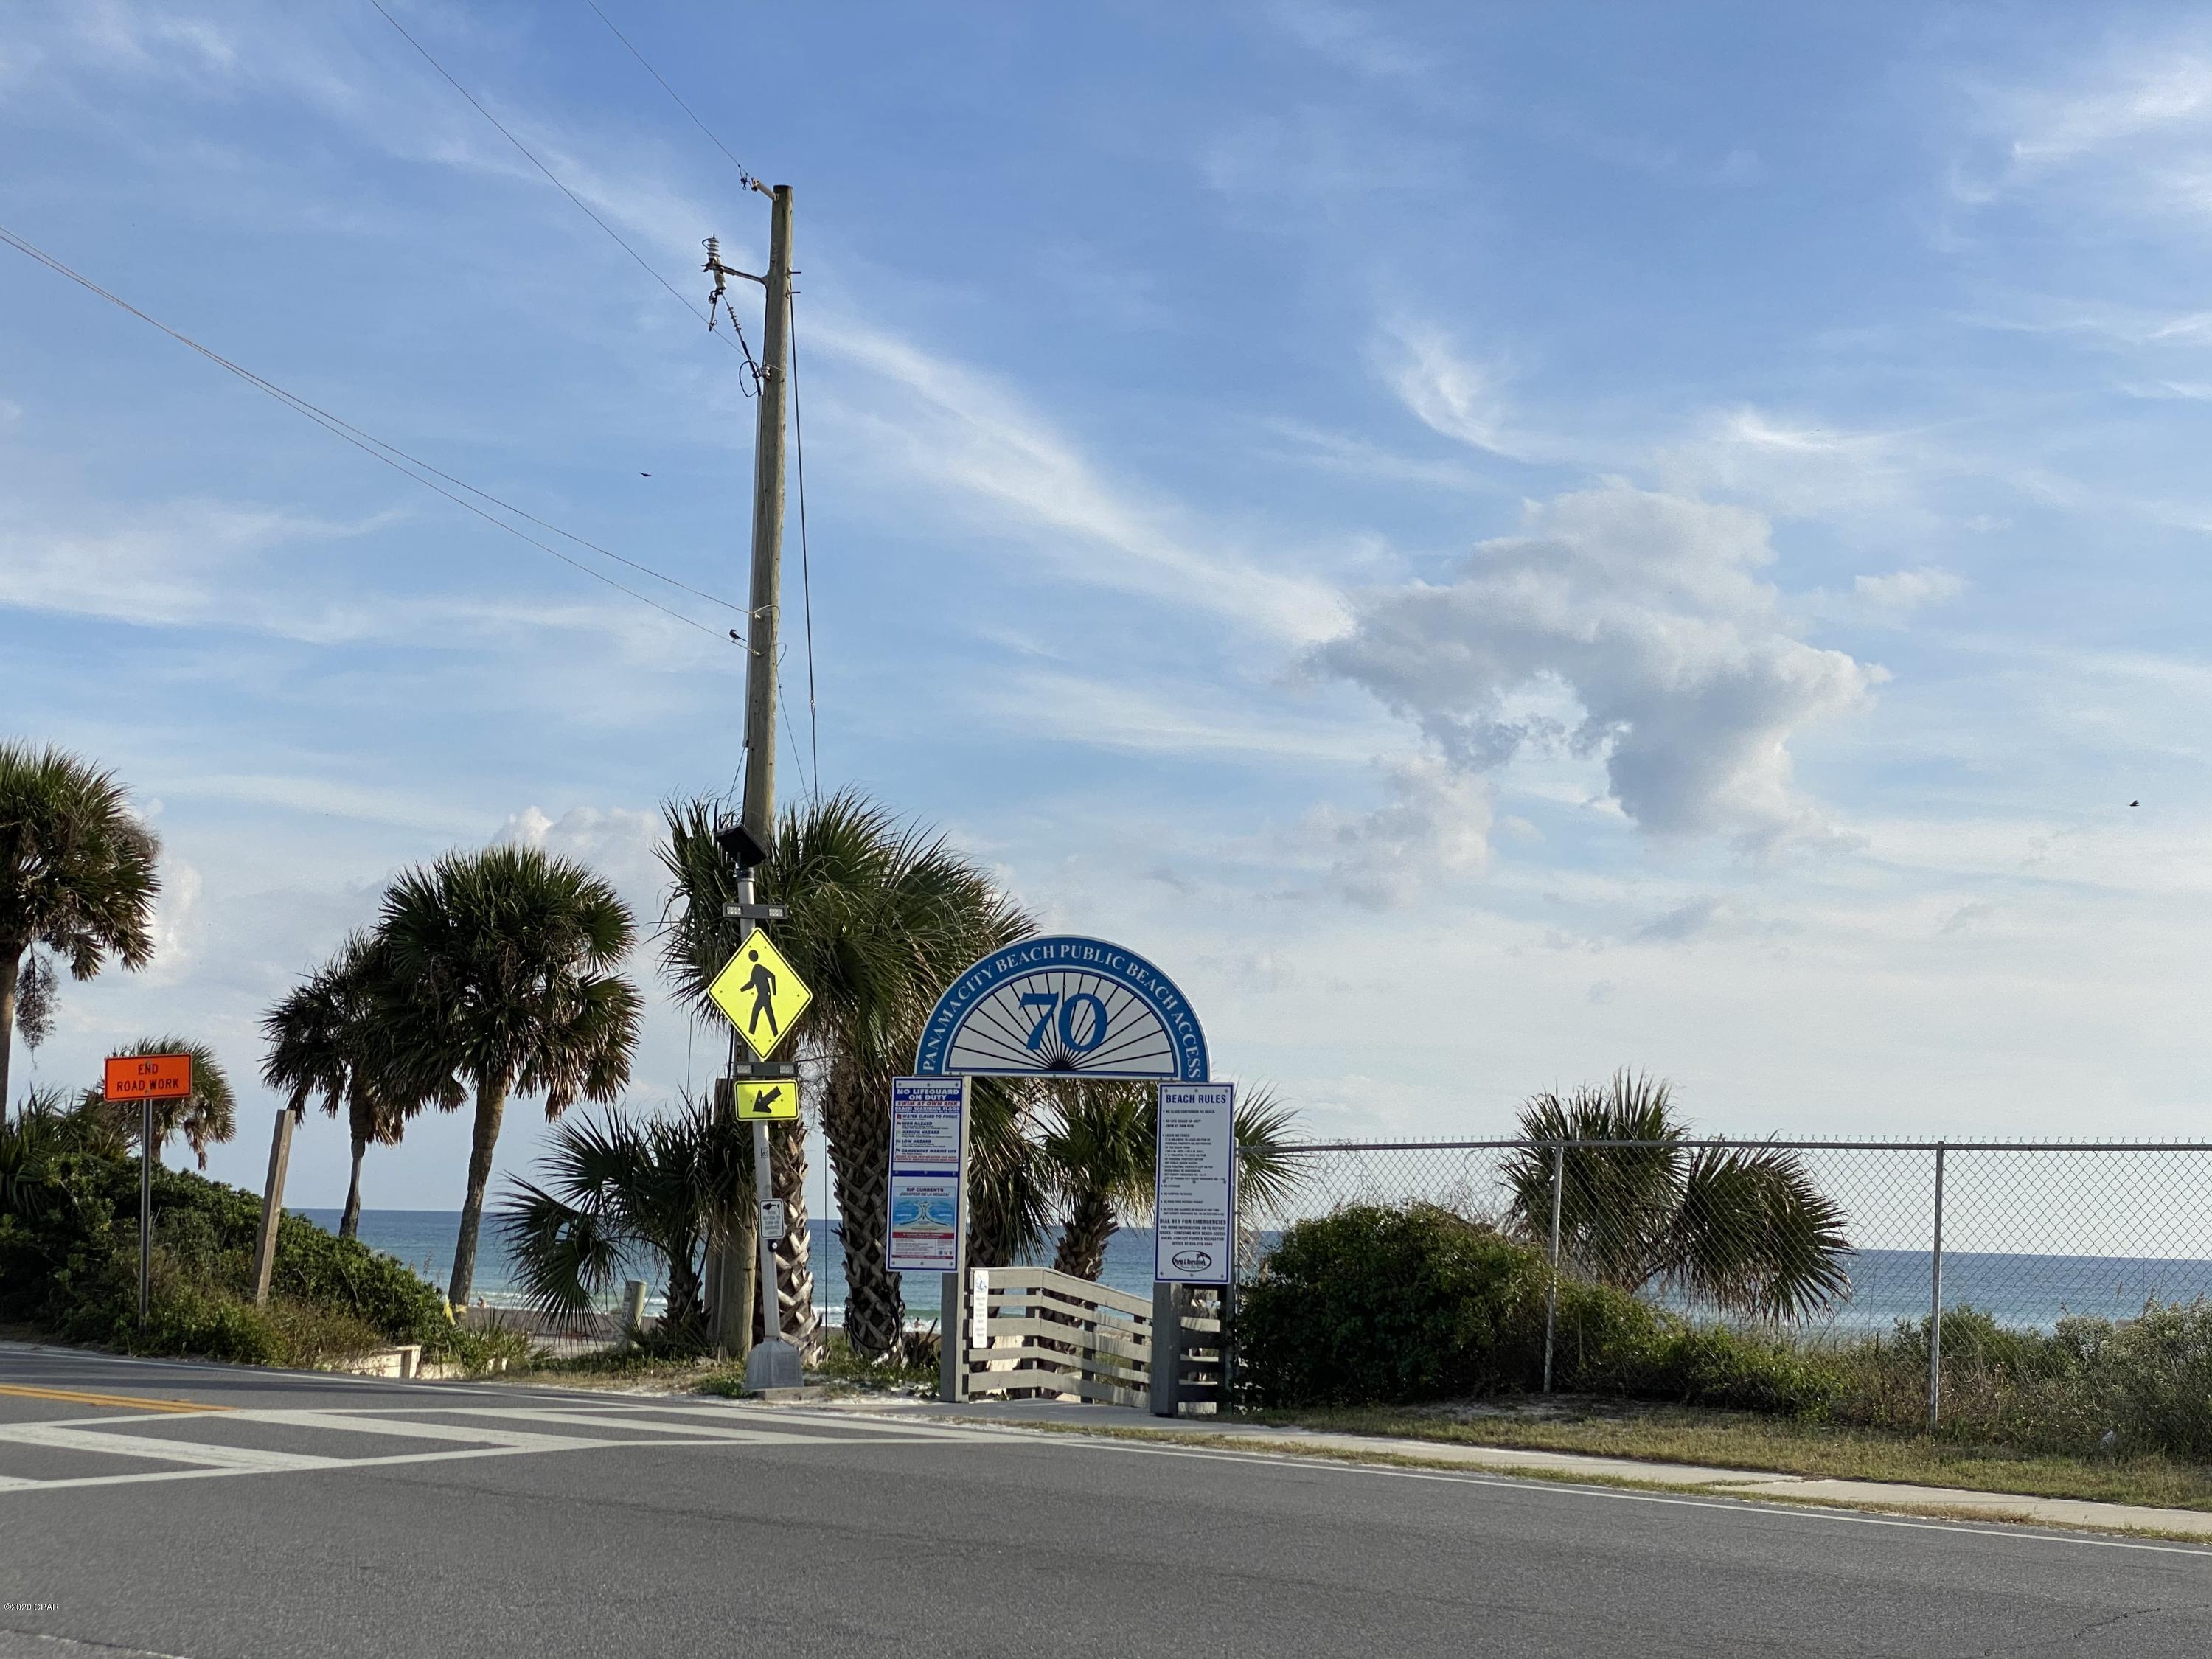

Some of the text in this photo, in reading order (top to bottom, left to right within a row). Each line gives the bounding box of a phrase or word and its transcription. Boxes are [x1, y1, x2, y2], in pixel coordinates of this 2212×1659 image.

[922, 945, 1201, 1079] PANAMA CITY BEACH PUBLIC BEACH ACCESS
[1018, 991, 1108, 1053] 70
[138, 1063, 159, 1075] END
[116, 1077, 179, 1092] ROAD WORK
[1166, 1094, 1226, 1104] BEACH RULES
